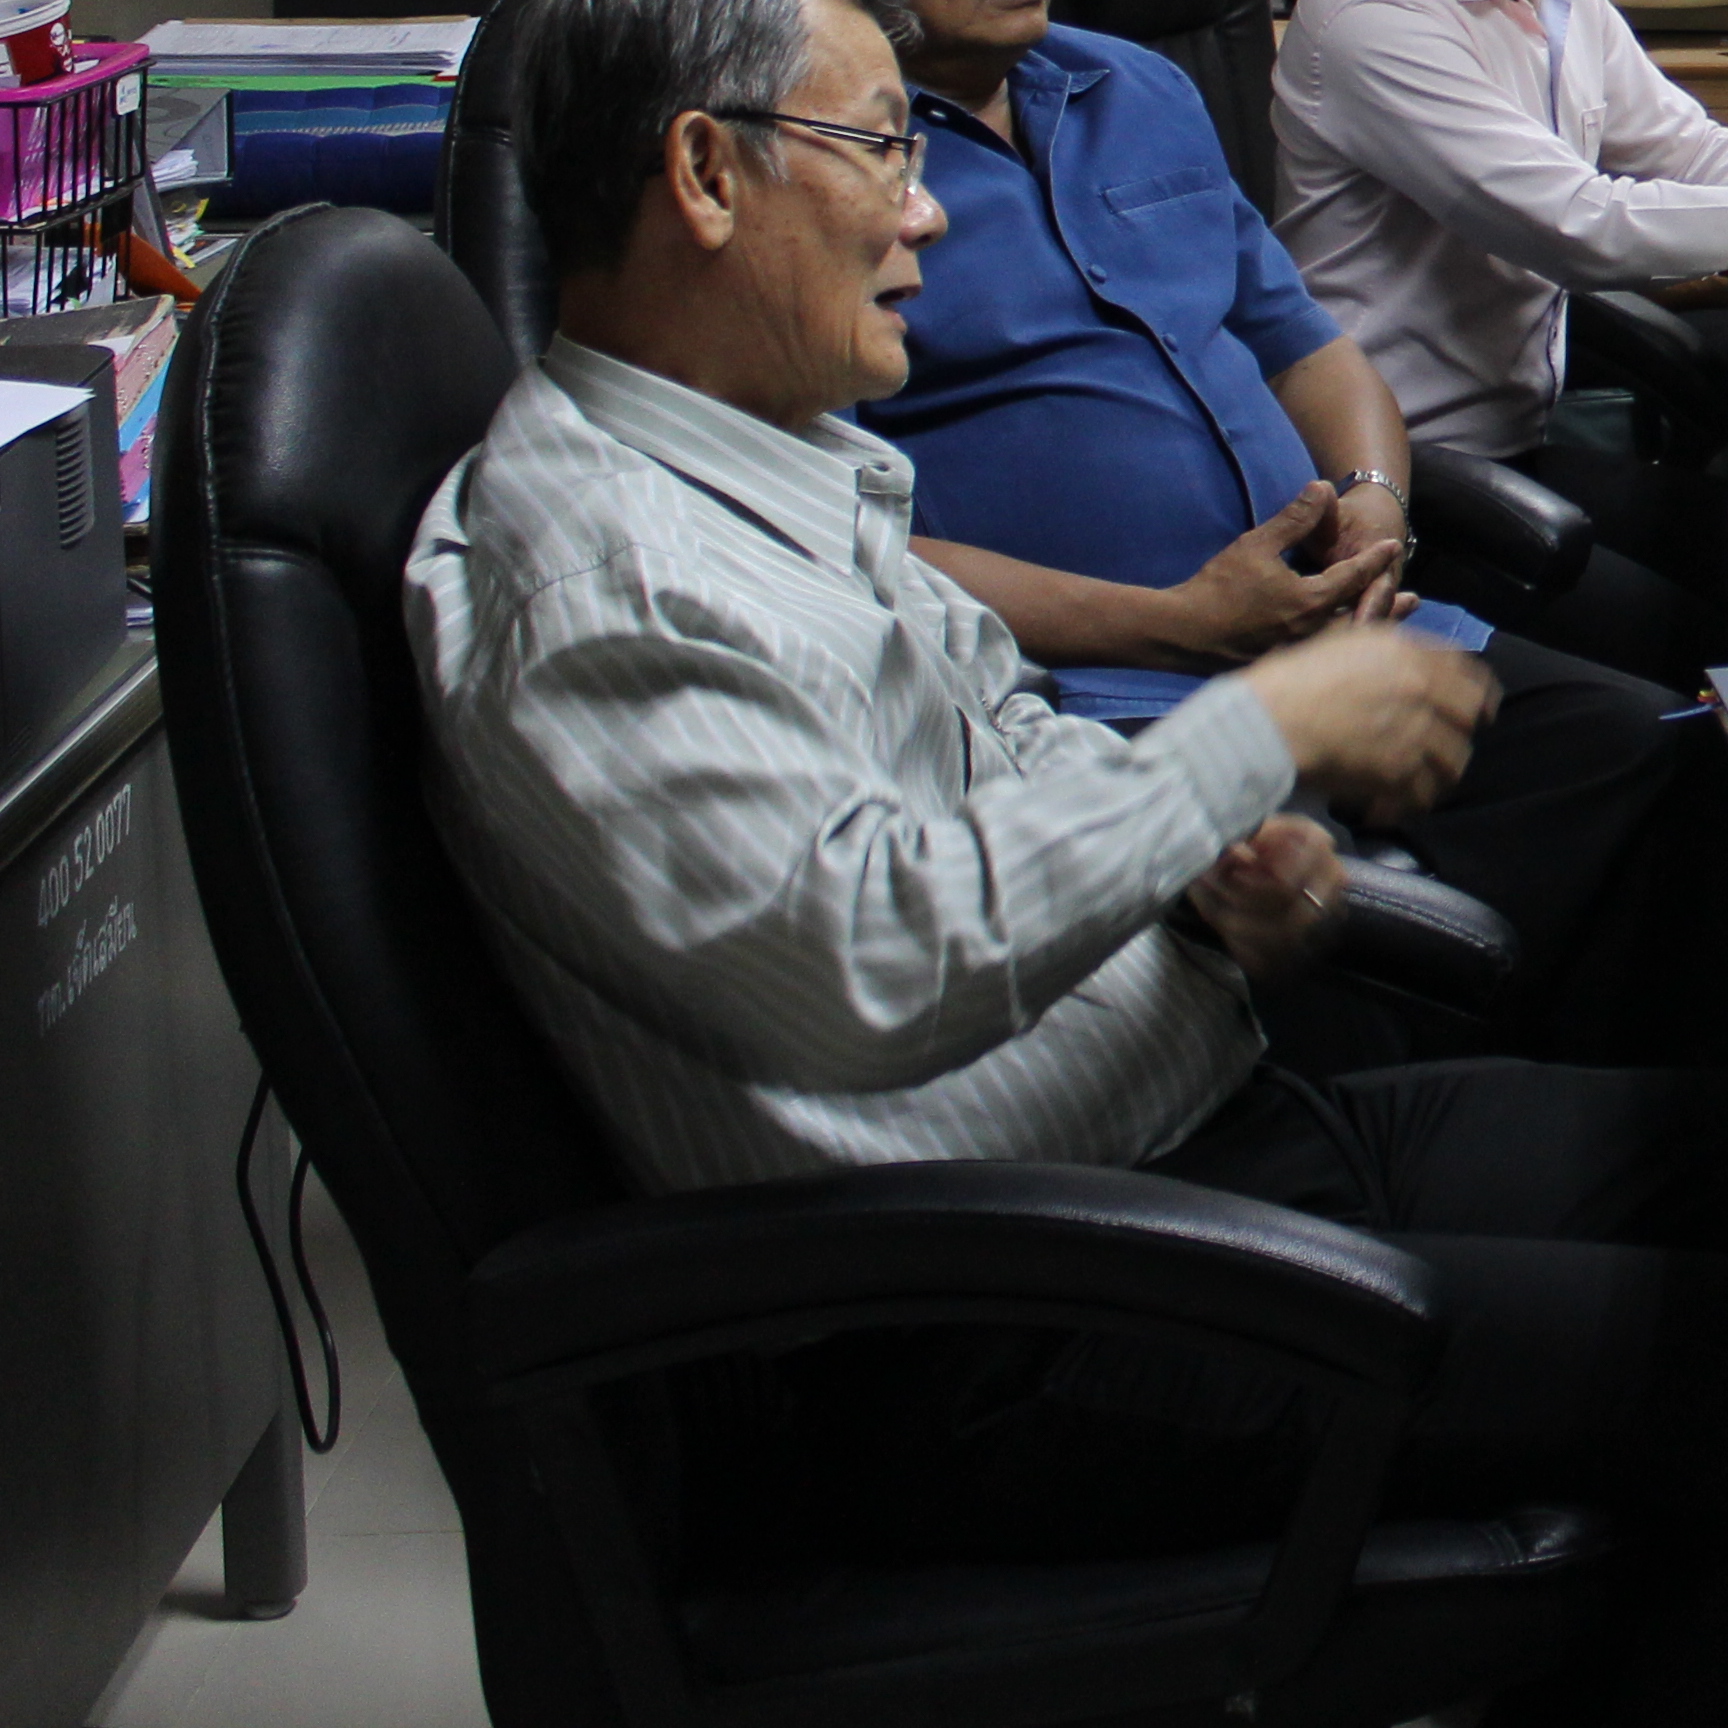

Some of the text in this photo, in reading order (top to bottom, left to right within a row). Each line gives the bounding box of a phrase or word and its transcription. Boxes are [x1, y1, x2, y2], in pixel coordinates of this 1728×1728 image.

[37, 783, 132, 927] 400 52 0077
